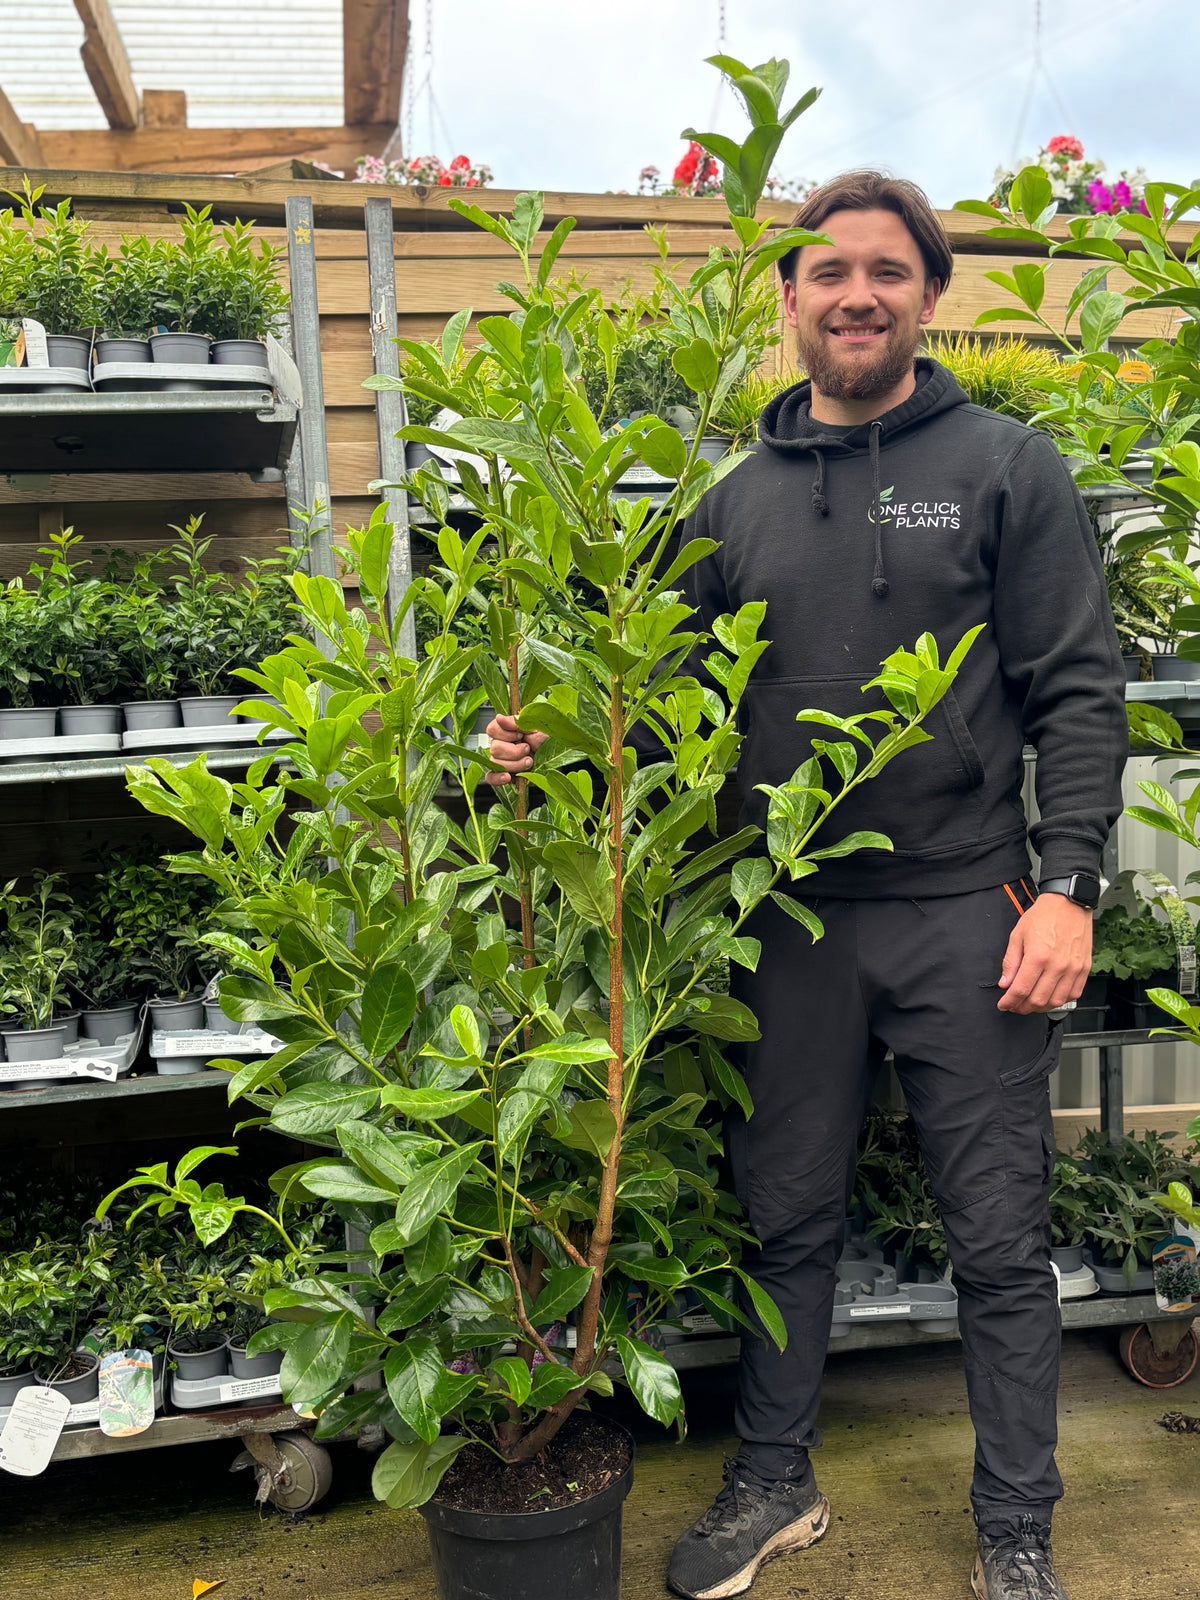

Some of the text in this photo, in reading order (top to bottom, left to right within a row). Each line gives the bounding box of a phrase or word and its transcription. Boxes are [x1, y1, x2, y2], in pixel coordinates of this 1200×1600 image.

[872, 502, 961, 516] ONE CLICK
[895, 516, 961, 530] PLANTS
